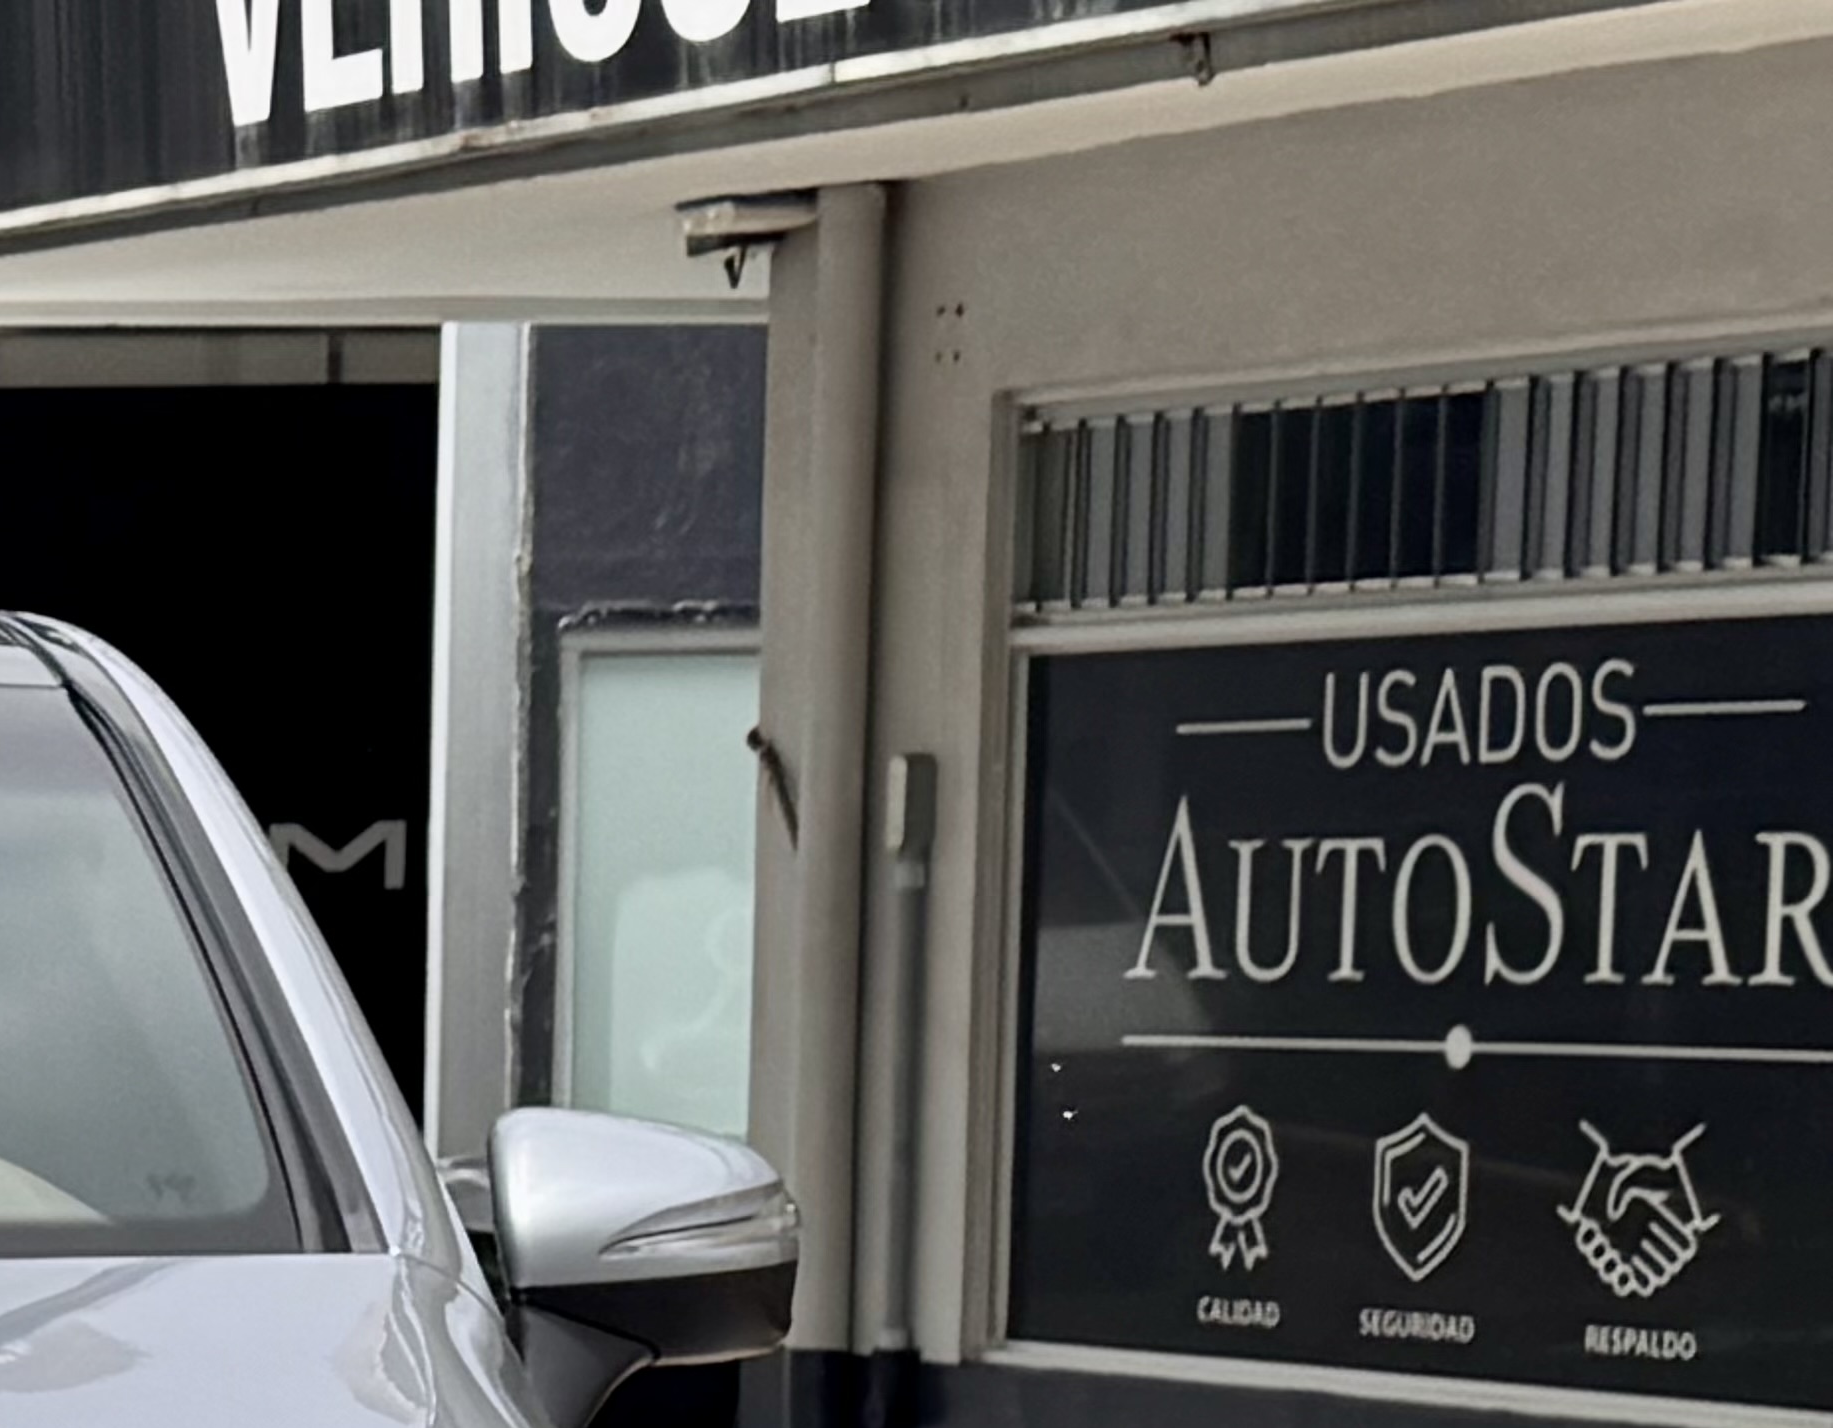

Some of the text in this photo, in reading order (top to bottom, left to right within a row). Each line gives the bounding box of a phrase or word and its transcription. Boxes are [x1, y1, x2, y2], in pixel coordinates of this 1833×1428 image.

[1321, 657, 1638, 769] USADOS
[1196, 1295, 1281, 1329] CALIDAD
[1359, 1307, 1476, 1344] SEGURIDAD
[1584, 1324, 1697, 1361] RESPALDO
